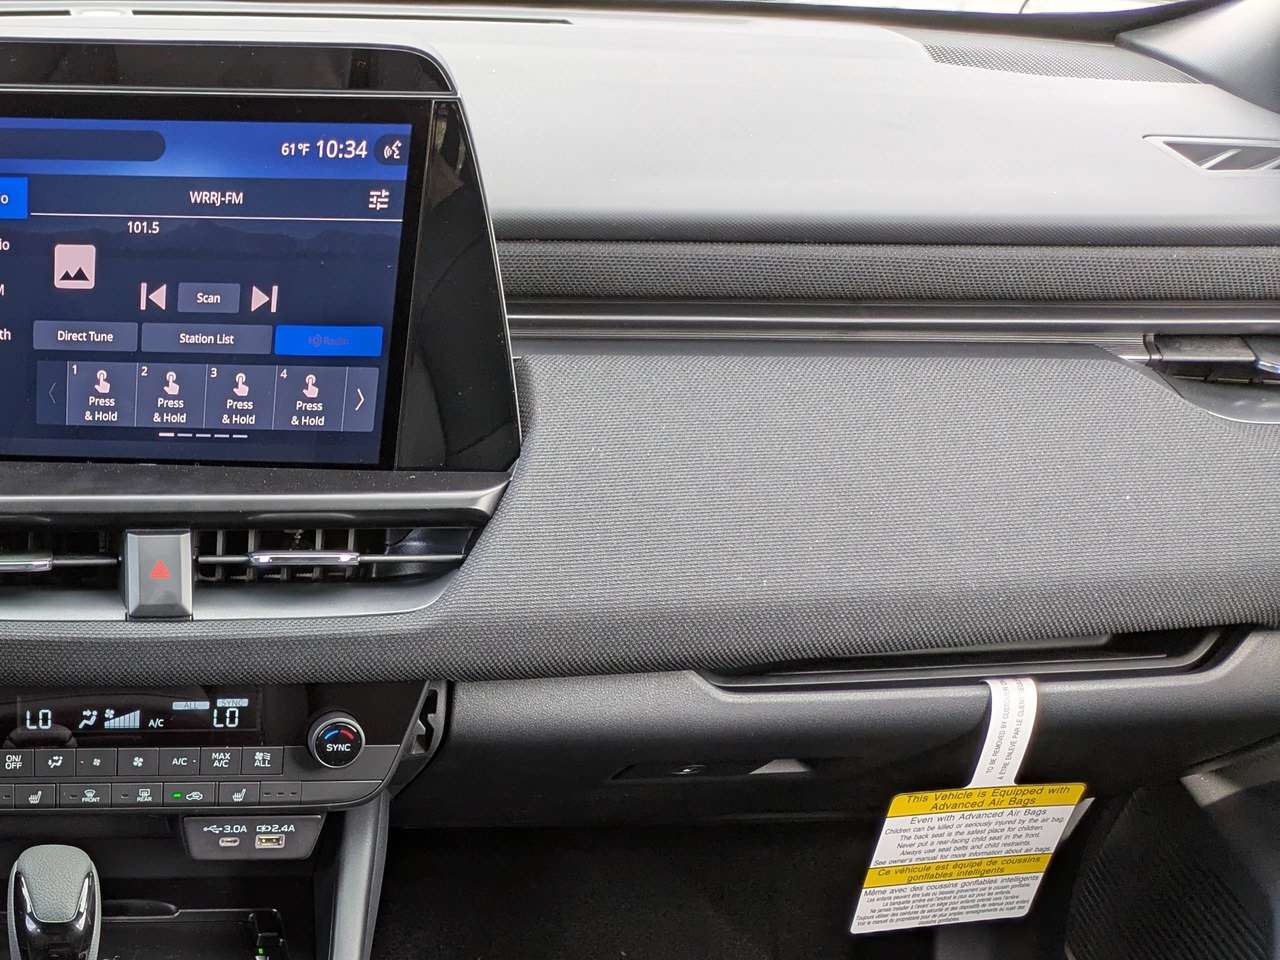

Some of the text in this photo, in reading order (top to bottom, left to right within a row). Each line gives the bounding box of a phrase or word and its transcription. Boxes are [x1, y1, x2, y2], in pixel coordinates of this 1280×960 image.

[281, 140, 367, 159] 61°F 10:34
[190, 191, 243, 206] WRRJ-FM
[127, 222, 160, 234] 101.5
[196, 292, 220, 304] Scan
[57, 330, 113, 342] Direct Tune
[180, 332, 234, 344] Station List
[72, 365, 78, 374] 1
[141, 366, 147, 376] 2
[210, 368, 217, 378] 3
[280, 369, 287, 378] 4
[88, 396, 115, 408] Press
[157, 398, 184, 409] Press
[226, 399, 253, 410] Press
[296, 400, 322, 412] Press
[84, 410, 118, 422] & Hold
[153, 412, 186, 424] & Hold
[222, 414, 255, 425] & Hold
[291, 415, 324, 426] & Hold
[26, 708, 238, 730] LO A/C LO
[326, 744, 351, 752] SYNC
[6, 754, 22, 762] ON/
[212, 752, 230, 760] MAX
[6, 762, 22, 770] OFF
[172, 758, 188, 766] A/C
[213, 760, 229, 768] A/C
[907, 786, 1070, 804] This Vehicle is Equipped with
[930, 797, 1036, 811] Advanced Air Bags
[910, 816, 933, 824] Even
[958, 811, 1004, 820] Advanced
[224, 824, 296, 833] 3.0A 2.4A
[878, 868, 890, 876] Ce
[907, 867, 1004, 883] gonflables intelligents
